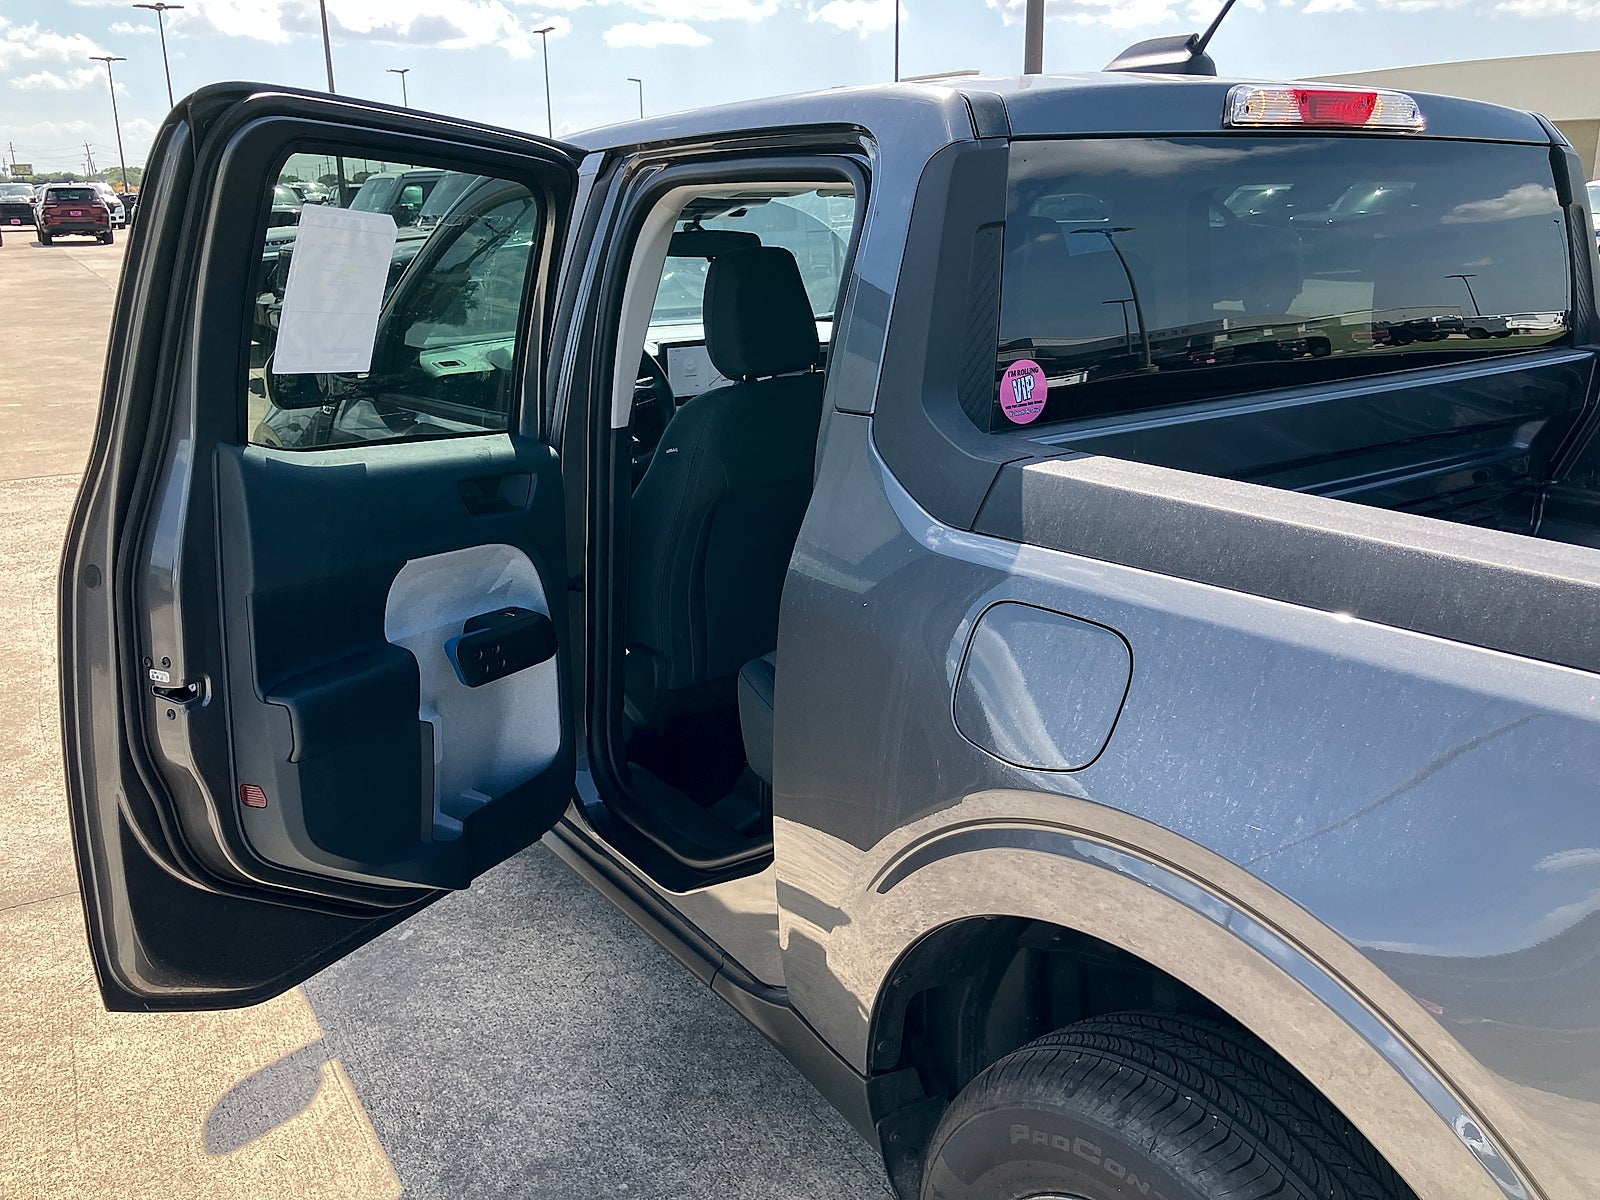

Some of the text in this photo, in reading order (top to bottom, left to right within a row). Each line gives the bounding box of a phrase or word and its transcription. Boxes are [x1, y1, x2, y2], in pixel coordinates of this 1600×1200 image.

[1007, 366, 1039, 378] I'M ROLLING
[1012, 374, 1035, 403] VIP
